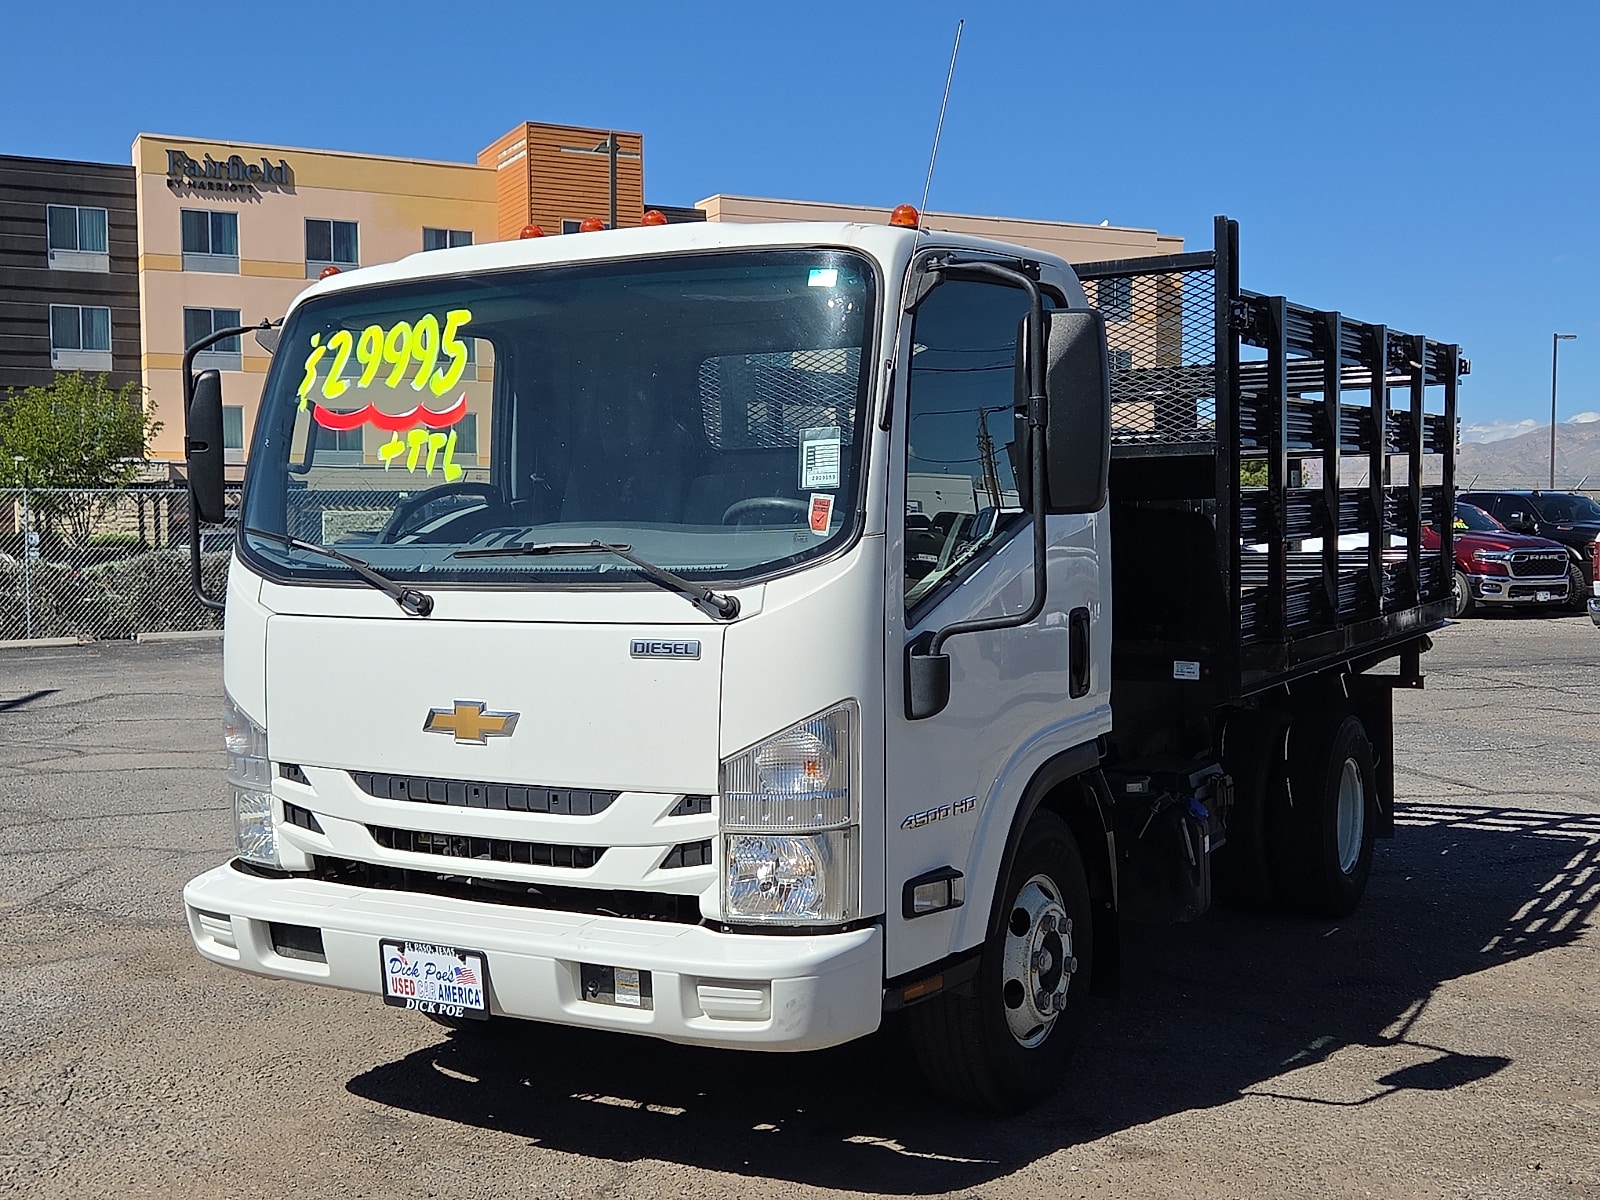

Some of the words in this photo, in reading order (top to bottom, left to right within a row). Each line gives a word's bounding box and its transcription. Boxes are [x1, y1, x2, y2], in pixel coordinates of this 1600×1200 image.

[165, 149, 289, 184] Fairfield
[188, 180, 254, 194] MARRIOTT
[633, 642, 695, 655] DIESEL
[900, 804, 951, 830] 4500
[953, 795, 977, 816] HD
[404, 941, 414, 952] EL
[434, 945, 456, 957] TEXAS
[389, 957, 420, 978] Dick
[424, 961, 455, 983] Poe's
[391, 976, 416, 996] USED
[417, 980, 437, 1001] CAR
[438, 983, 482, 1007] AMERICA
[405, 998, 436, 1014] DICK
[437, 1003, 465, 1018] POE
